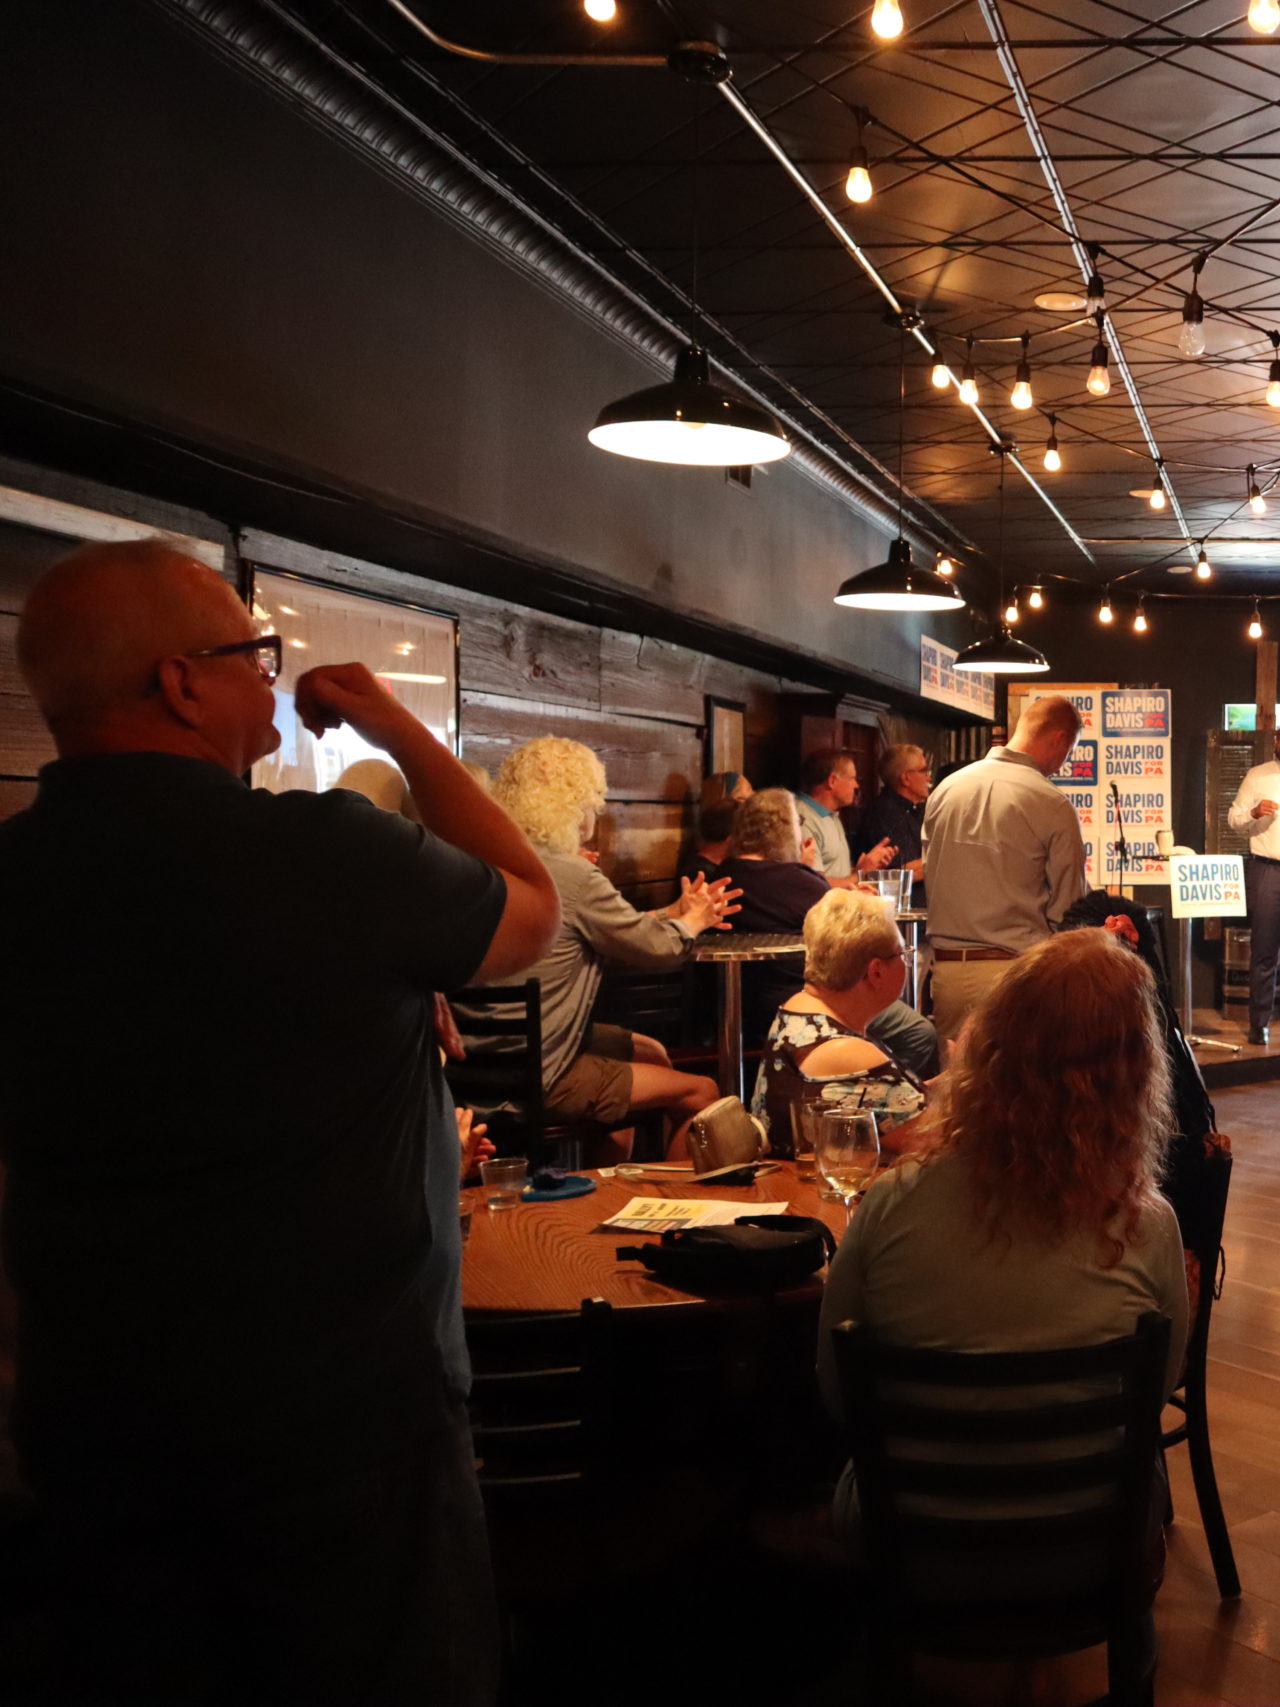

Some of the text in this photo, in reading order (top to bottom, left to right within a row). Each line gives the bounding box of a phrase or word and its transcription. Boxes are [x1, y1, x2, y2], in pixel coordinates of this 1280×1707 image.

[1105, 696, 1165, 713] SHAPIRO
[1106, 713, 1144, 728] DAVIS
[1146, 719, 1165, 728] PA
[1105, 745, 1164, 759] SHAPIRO
[1073, 768, 1094, 777] PA
[1106, 761, 1142, 775] DAVIS
[1145, 767, 1164, 775] PA
[1145, 864, 1164, 872] PA
[1178, 863, 1240, 882] SHAPIRO
[1179, 884, 1223, 902] DAVIS
[1224, 891, 1241, 901] PA
